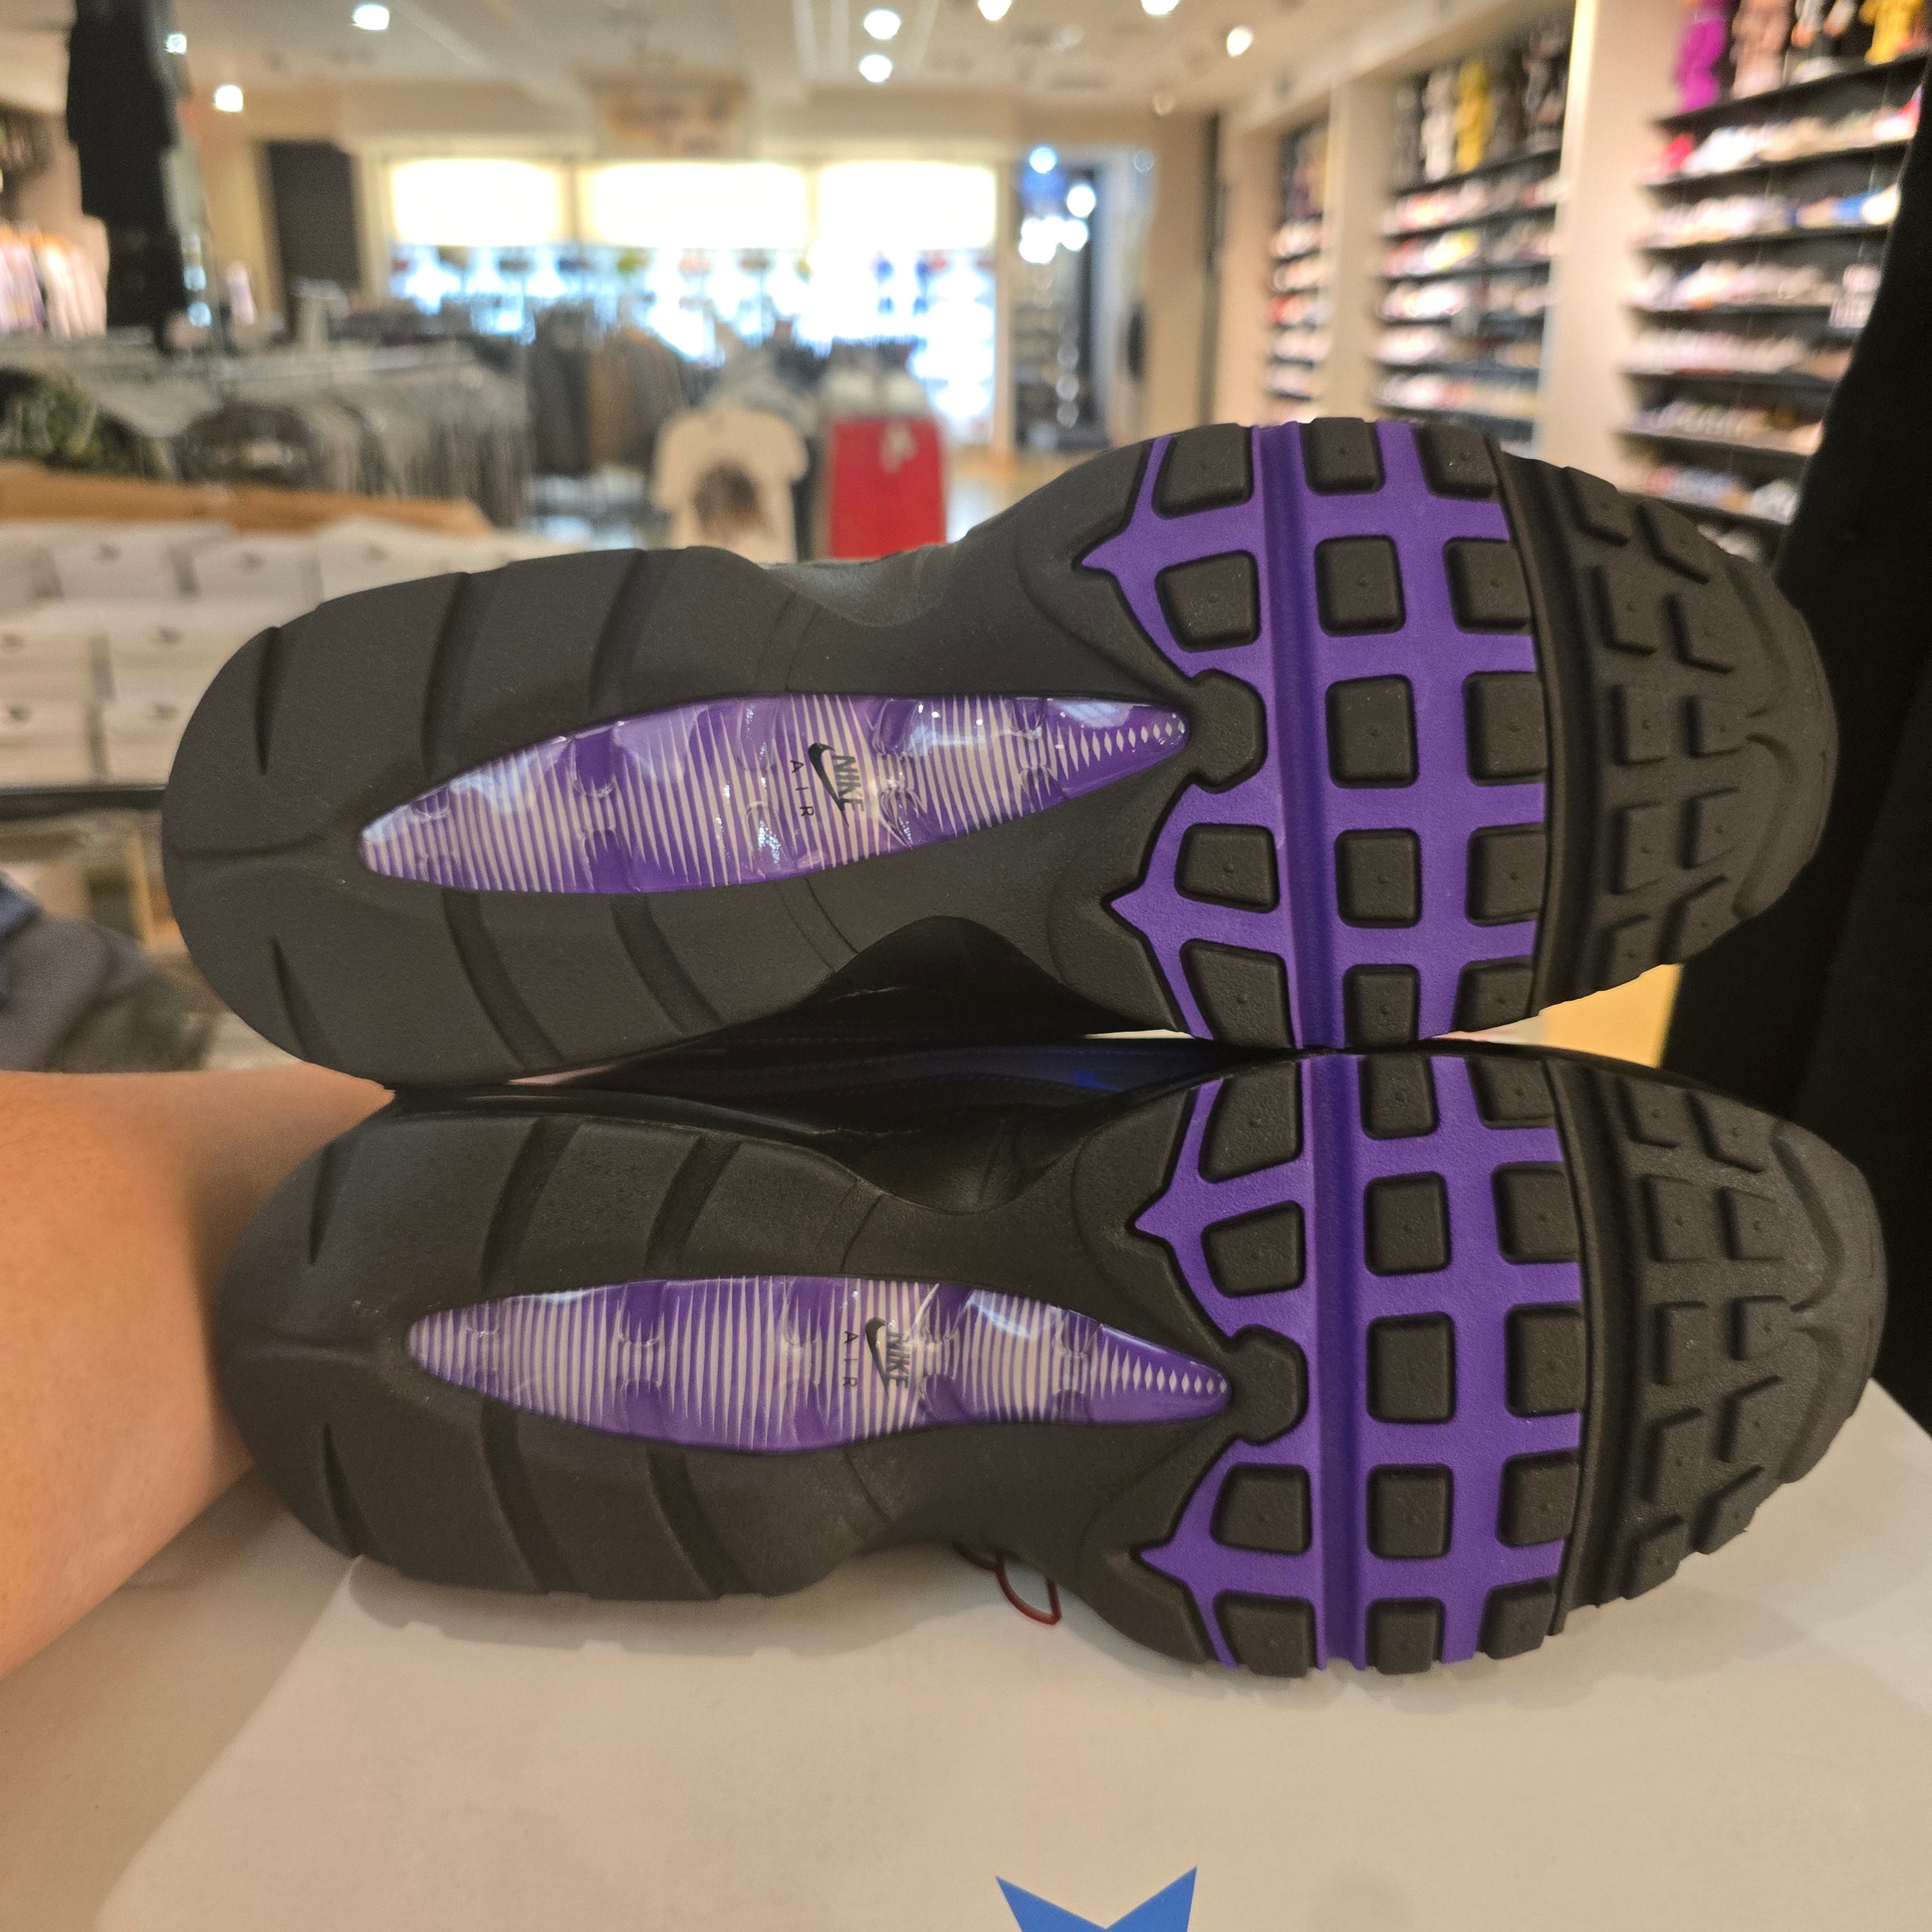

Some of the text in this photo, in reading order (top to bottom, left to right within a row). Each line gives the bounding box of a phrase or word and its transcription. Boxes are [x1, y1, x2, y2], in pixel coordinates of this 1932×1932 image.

[790, 759, 814, 817] AIR
[831, 755, 865, 812] NIKE
[842, 1330, 859, 1387] AIR
